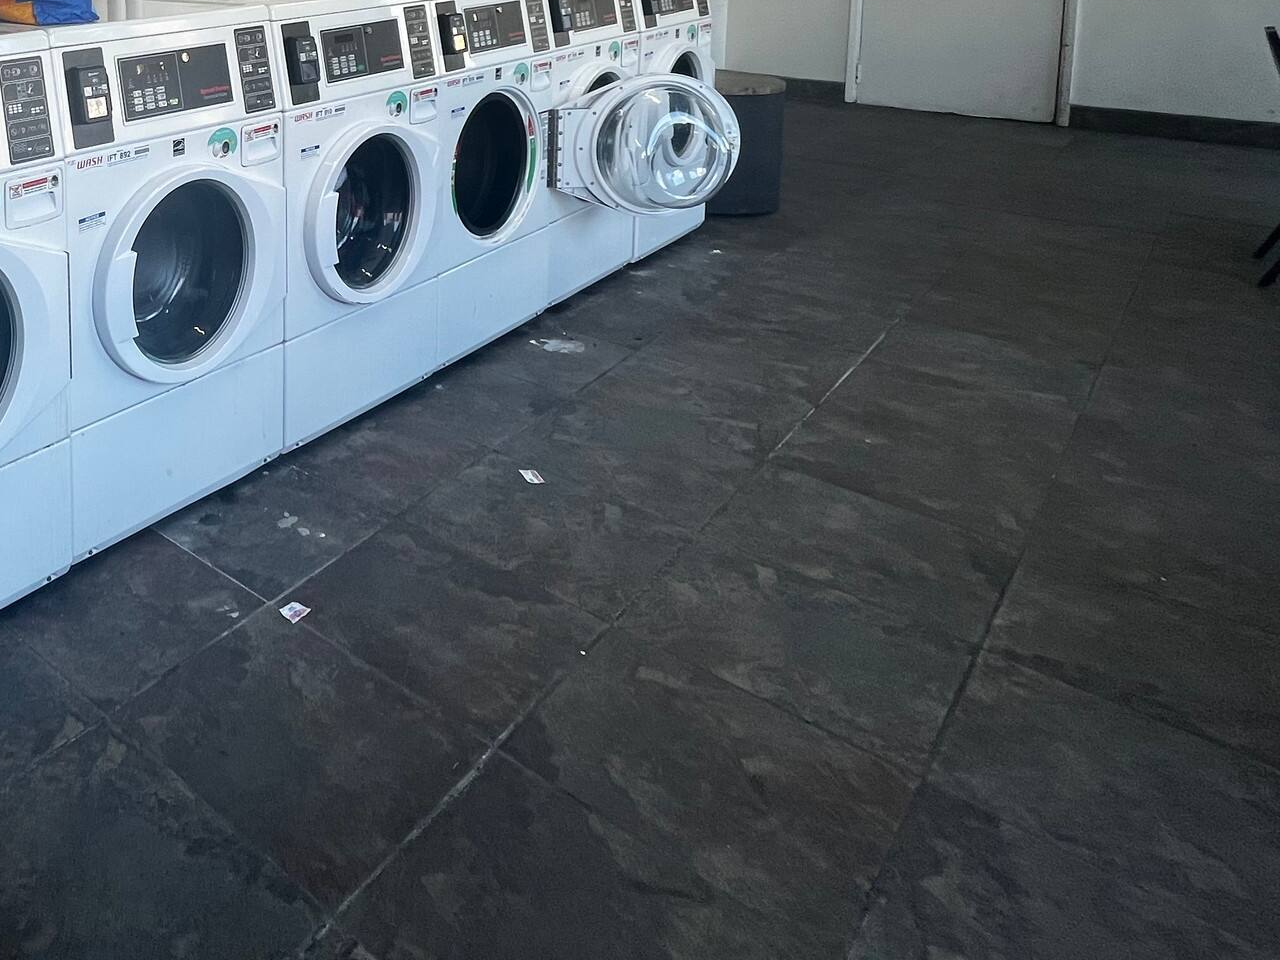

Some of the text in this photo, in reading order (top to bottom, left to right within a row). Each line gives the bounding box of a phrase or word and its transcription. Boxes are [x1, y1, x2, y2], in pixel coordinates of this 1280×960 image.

[294, 111, 313, 122] WASH
[76, 156, 103, 169] WASH
[107, 153, 117, 162] IFT
